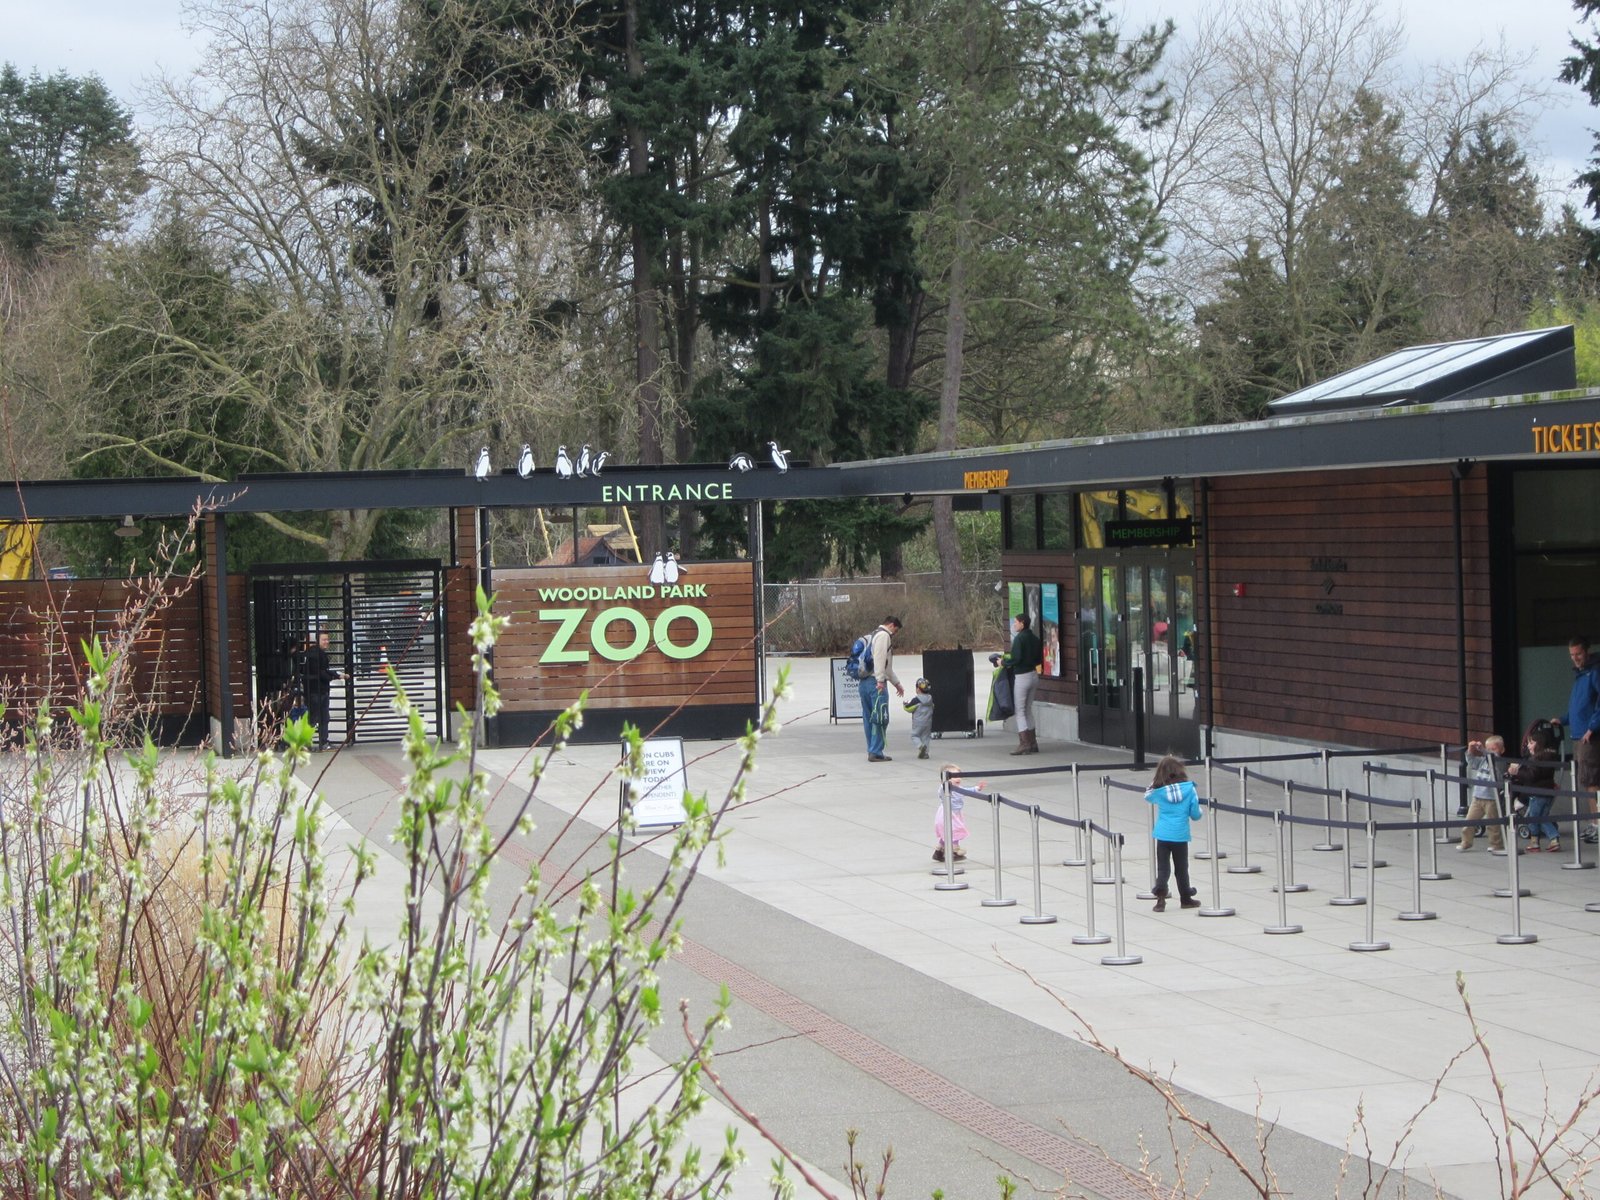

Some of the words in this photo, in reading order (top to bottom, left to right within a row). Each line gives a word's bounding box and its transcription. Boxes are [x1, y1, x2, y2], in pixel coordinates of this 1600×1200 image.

[1532, 421, 1600, 454] TICKETS
[964, 469, 1009, 489] MEMBERSHIP
[602, 483, 733, 502] ENTRANCE
[1111, 526, 1181, 539] MEMBERSHIP
[538, 585, 655, 602] WOODLAND
[660, 583, 707, 599] PARK
[538, 604, 713, 664] ZOO
